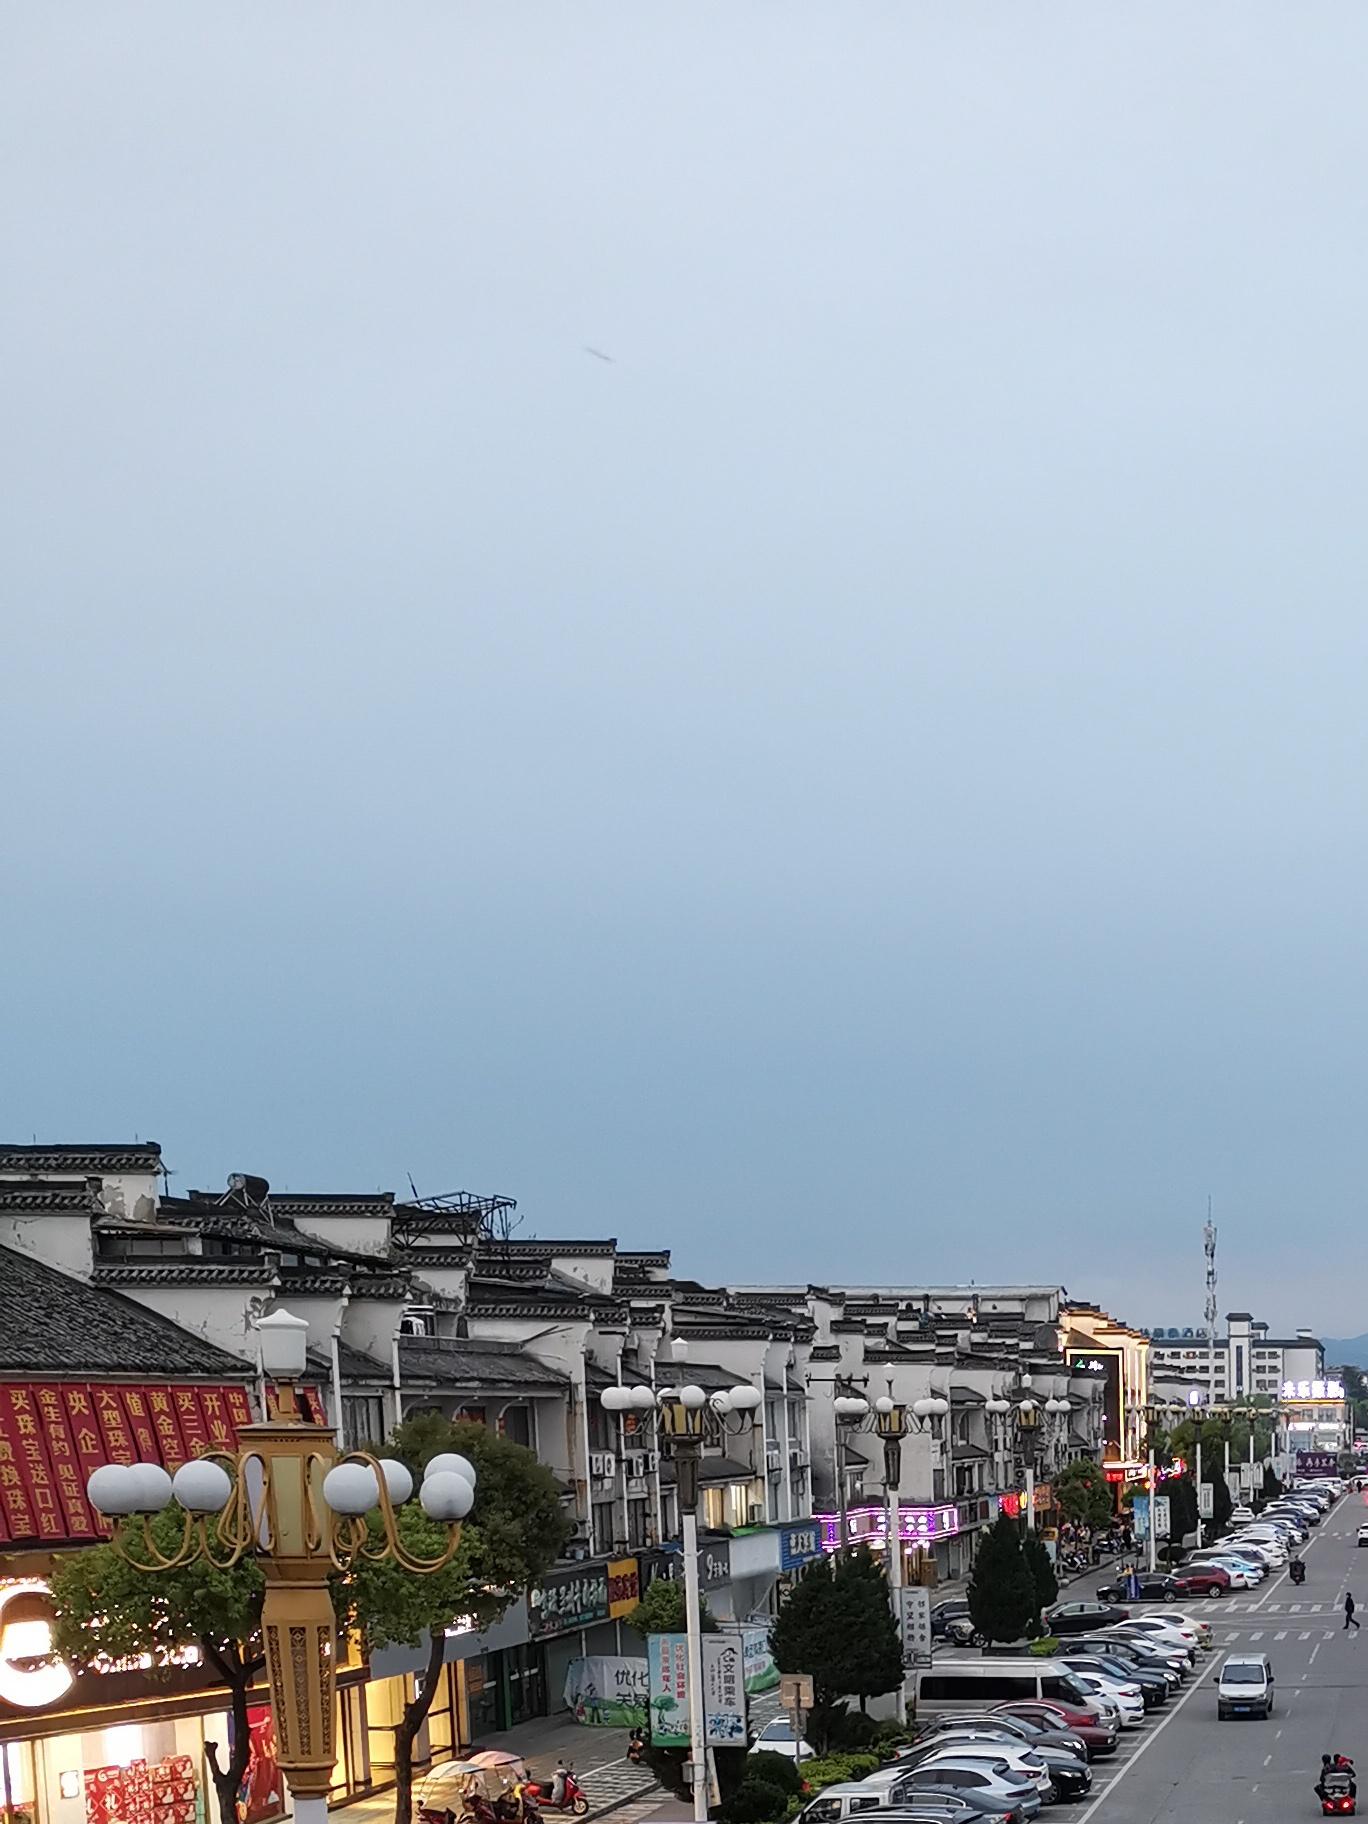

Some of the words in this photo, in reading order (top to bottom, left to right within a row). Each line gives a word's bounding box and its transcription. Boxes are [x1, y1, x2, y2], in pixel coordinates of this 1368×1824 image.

[9, 1389, 61, 1534] 买珠宝送口红
[203, 1392, 230, 1451] 开业
